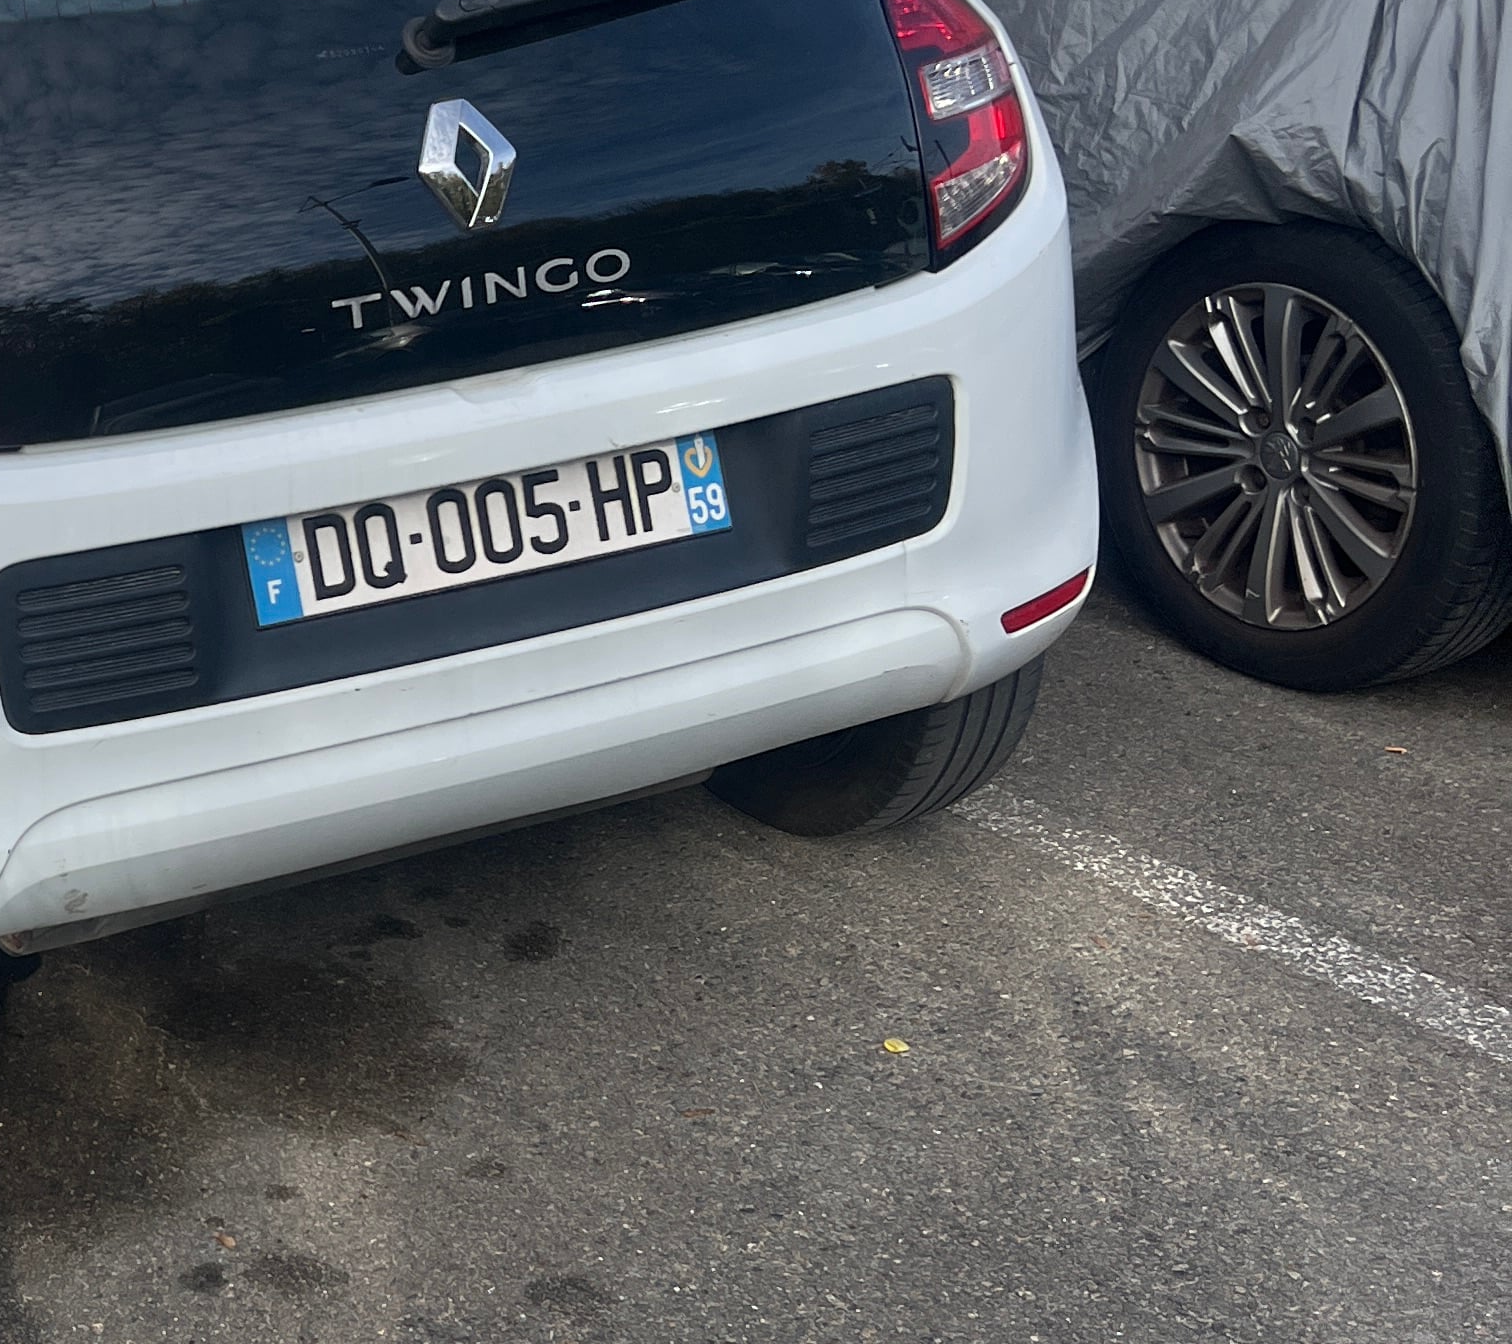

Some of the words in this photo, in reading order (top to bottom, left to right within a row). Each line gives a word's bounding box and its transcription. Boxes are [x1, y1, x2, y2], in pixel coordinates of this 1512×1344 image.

[331, 248, 631, 330] TWINGO
[267, 579, 283, 605] F
[688, 483, 726, 524] 59
